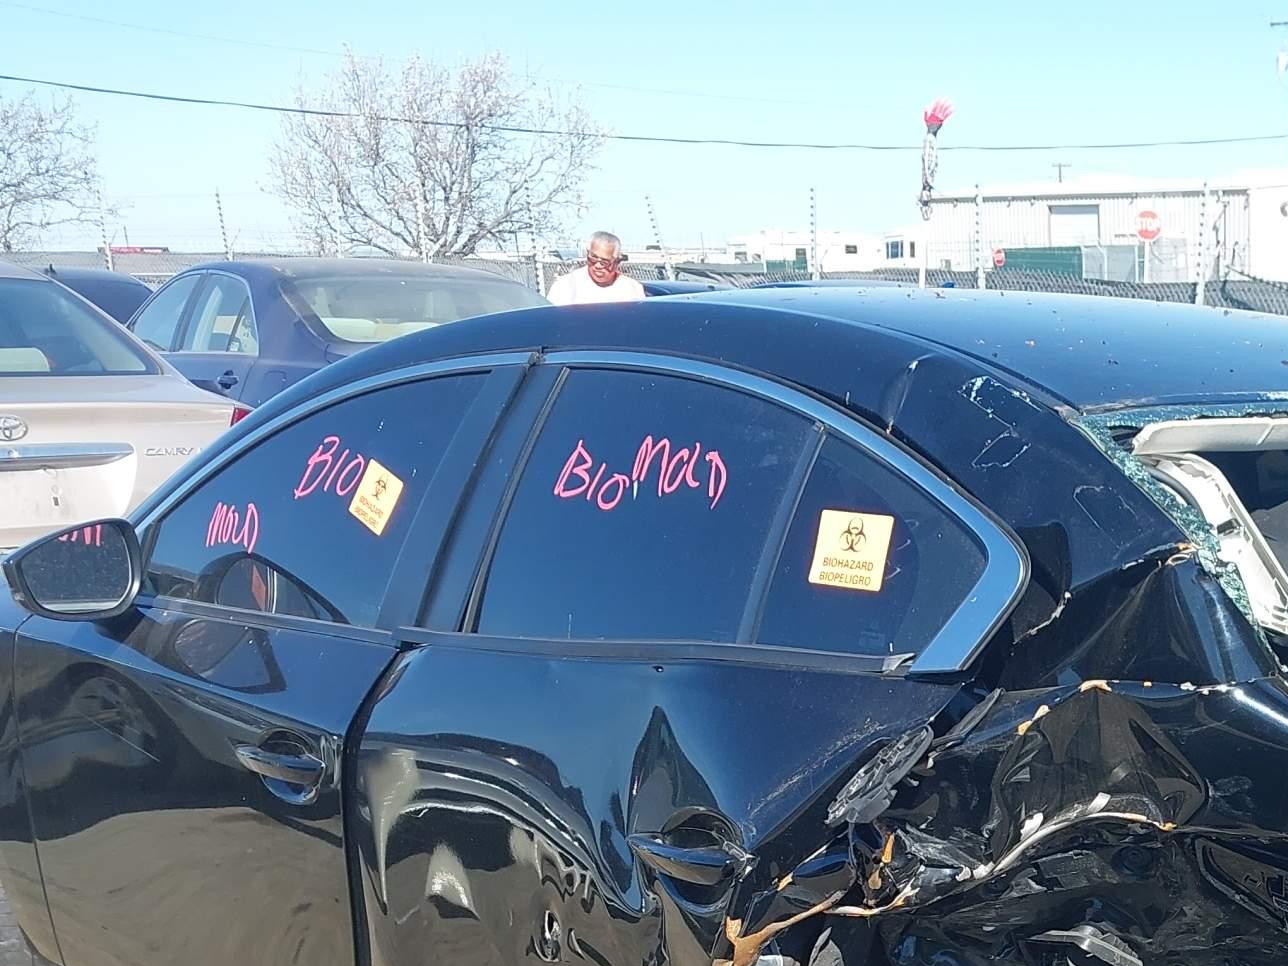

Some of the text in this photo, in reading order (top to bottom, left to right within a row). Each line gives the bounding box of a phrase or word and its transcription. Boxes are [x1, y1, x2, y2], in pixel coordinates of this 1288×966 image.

[144, 447, 194, 457] CAMRY
[822, 557, 874, 572] BIOHAZARD
[819, 571, 871, 587] BIOPELIGRO
